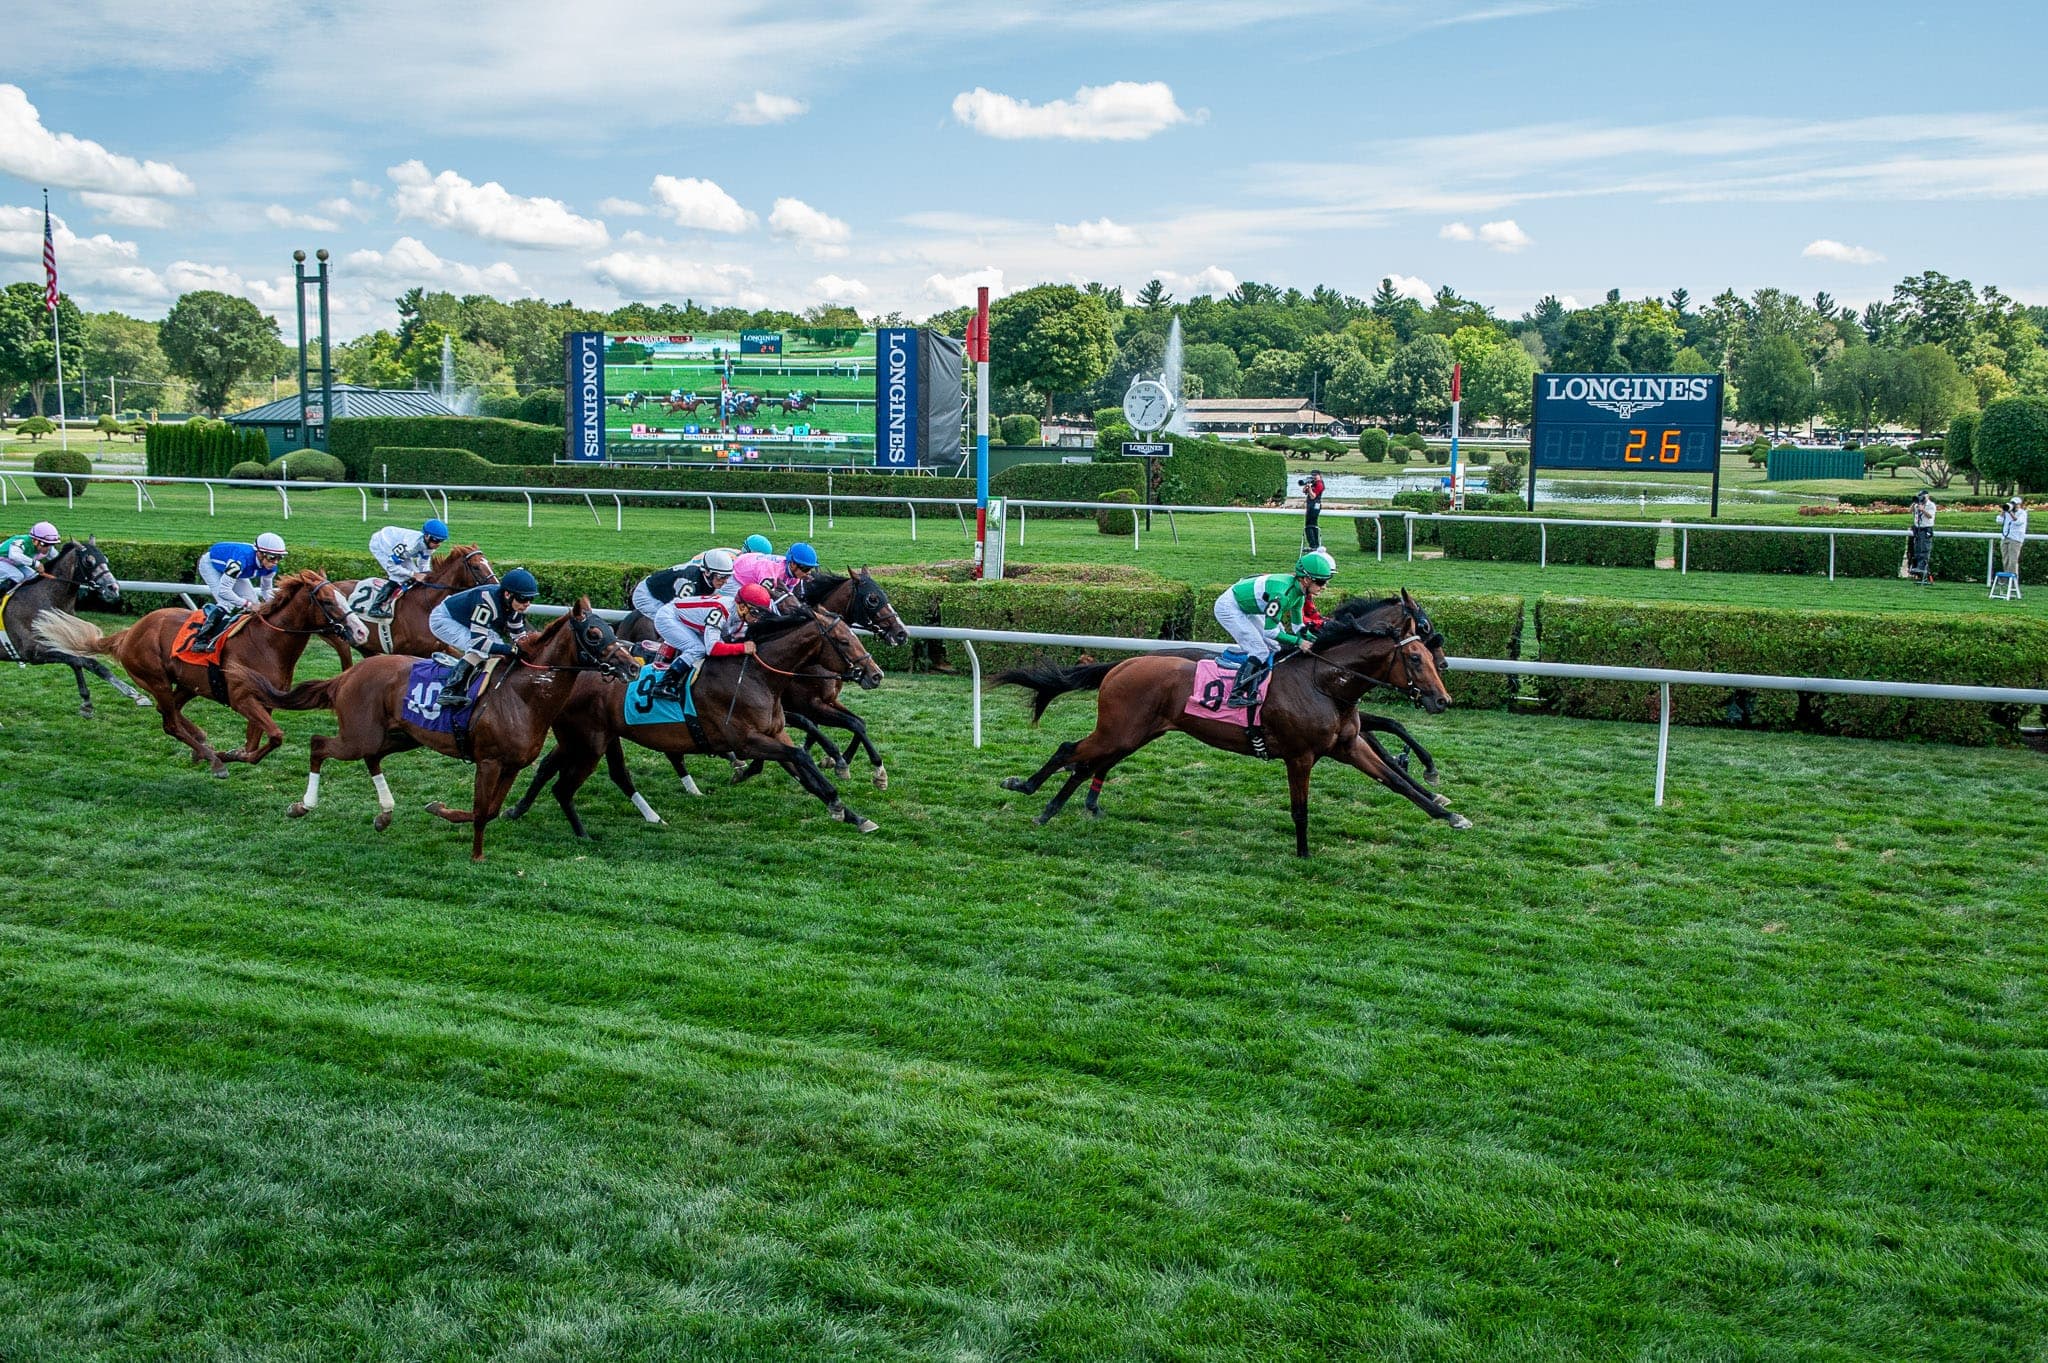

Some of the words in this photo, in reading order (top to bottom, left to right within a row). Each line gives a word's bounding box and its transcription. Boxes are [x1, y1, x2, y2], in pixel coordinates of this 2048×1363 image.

[582, 336, 599, 457] LONGINES
[889, 332, 906, 463] LONGINES
[1129, 444, 1164, 452] LONGINES
[1624, 429, 1681, 463] 2.6
[394, 544, 404, 557] 2
[226, 562, 241, 575] 7
[350, 586, 372, 614] 2
[679, 584, 694, 598] 6
[470, 604, 491, 625] 10
[706, 609, 719, 626] 9
[1266, 602, 1279, 616] 8
[407, 681, 444, 720] 10
[635, 674, 656, 713] 9
